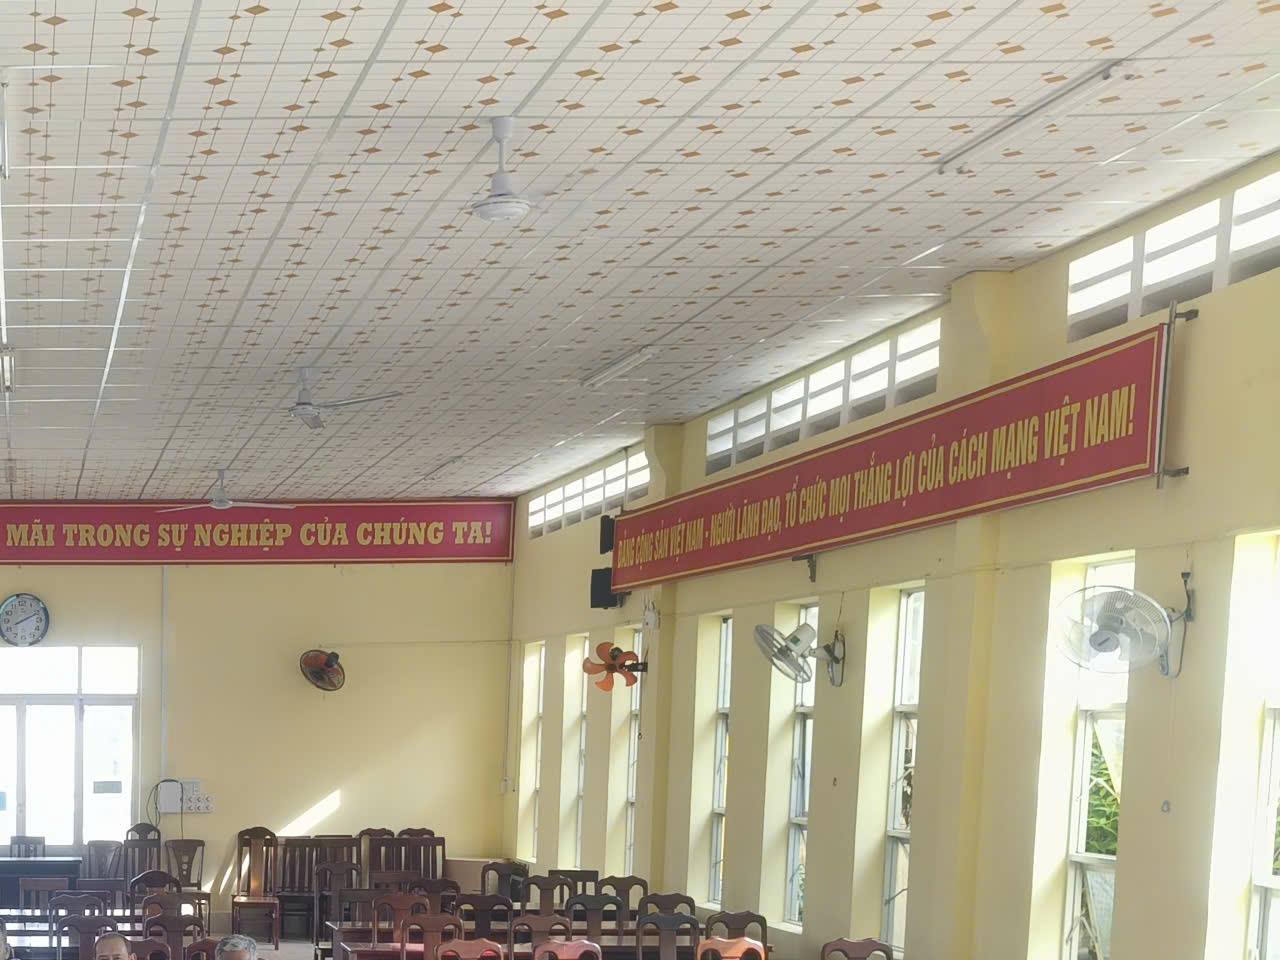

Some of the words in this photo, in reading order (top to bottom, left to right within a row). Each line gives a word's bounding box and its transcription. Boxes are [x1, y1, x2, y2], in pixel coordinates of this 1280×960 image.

[670, 517, 686, 562] VIỆT
[686, 518, 704, 551] NAM
[710, 503, 736, 547] NGƯỜI
[736, 499, 760, 540] LÃNH
[785, 475, 799, 528] TỔ
[799, 475, 827, 526] CHỨC
[828, 473, 851, 523] MỌI
[853, 451, 892, 511] THẮNG
[894, 451, 915, 507] LỢI
[918, 433, 945, 494] CỦA
[948, 428, 988, 486] CÁCH
[991, 415, 1040, 479] MẠNG
[1044, 395, 1081, 466] VIỆT
[1083, 383, 1137, 449] NAM!
[6, 518, 54, 547] MÃI
[63, 523, 150, 547] TRONG
[157, 522, 188, 552] SỰ
[193, 519, 292, 551] NGHIỆP
[299, 516, 349, 546] CỦA
[356, 516, 445, 546] CHÚNG
[452, 521, 493, 545] TA!
